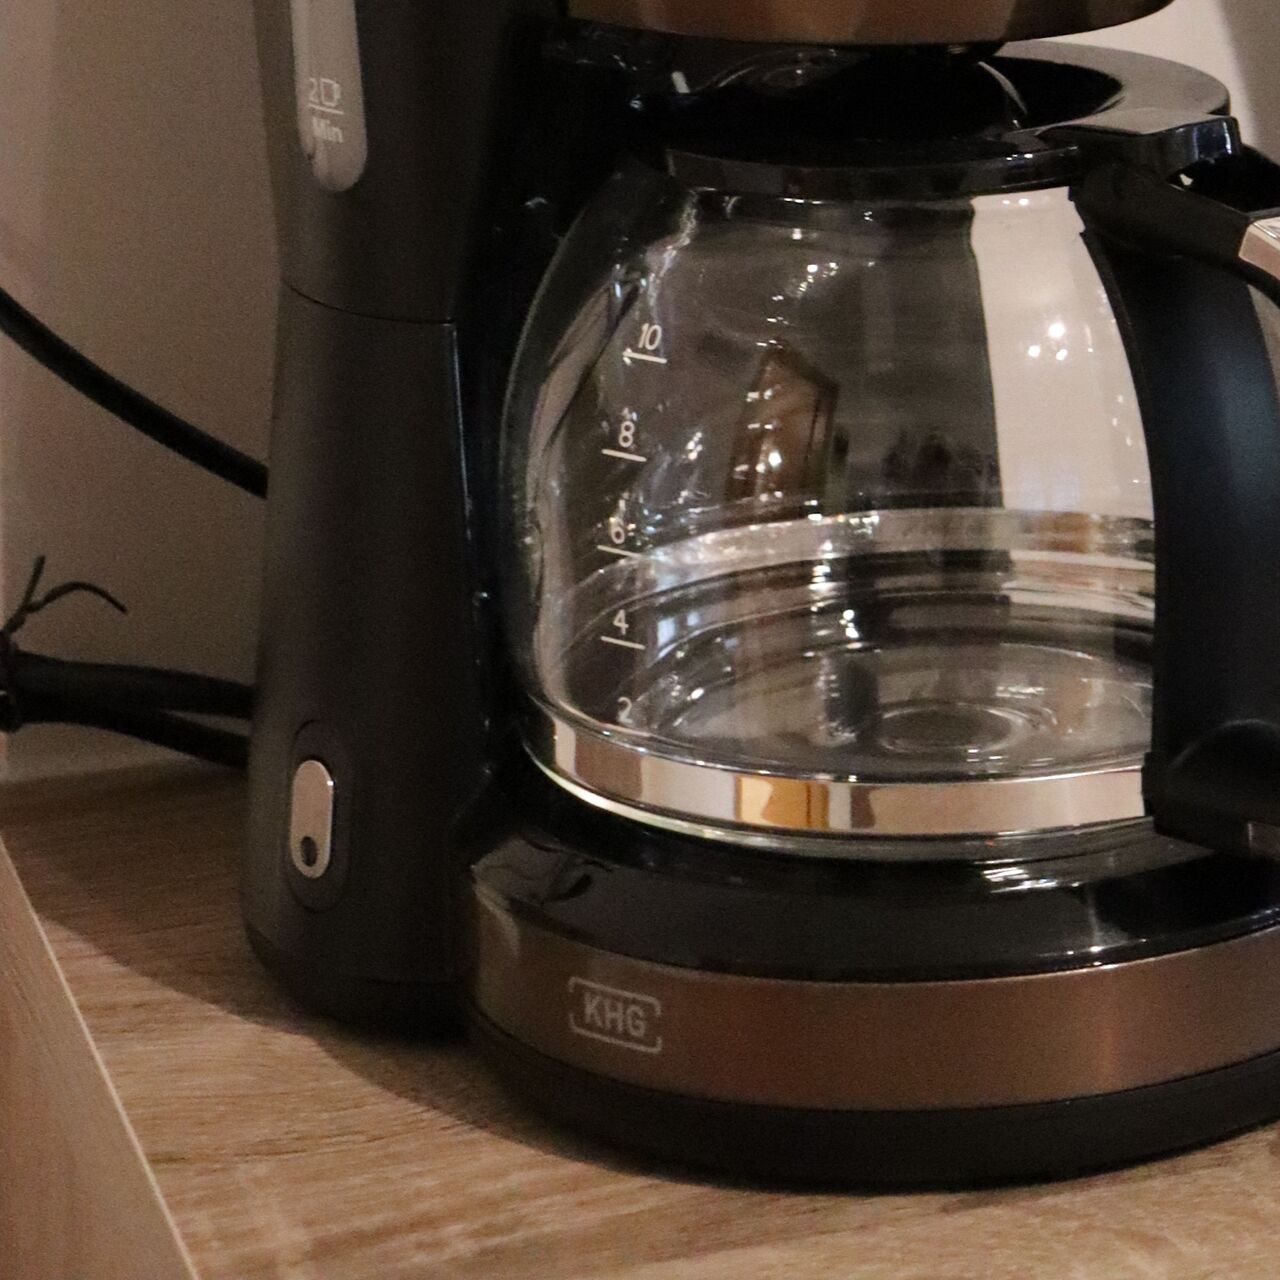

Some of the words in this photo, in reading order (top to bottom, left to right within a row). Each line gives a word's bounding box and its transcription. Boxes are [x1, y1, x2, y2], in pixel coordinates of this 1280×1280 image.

[308, 76, 319, 103] 2
[312, 115, 344, 145] Min
[638, 322, 662, 351] 10
[618, 420, 635, 448] 8
[610, 517, 626, 545] 6
[612, 608, 630, 636] 4
[617, 696, 634, 724] 2
[583, 991, 647, 1039] KHG
